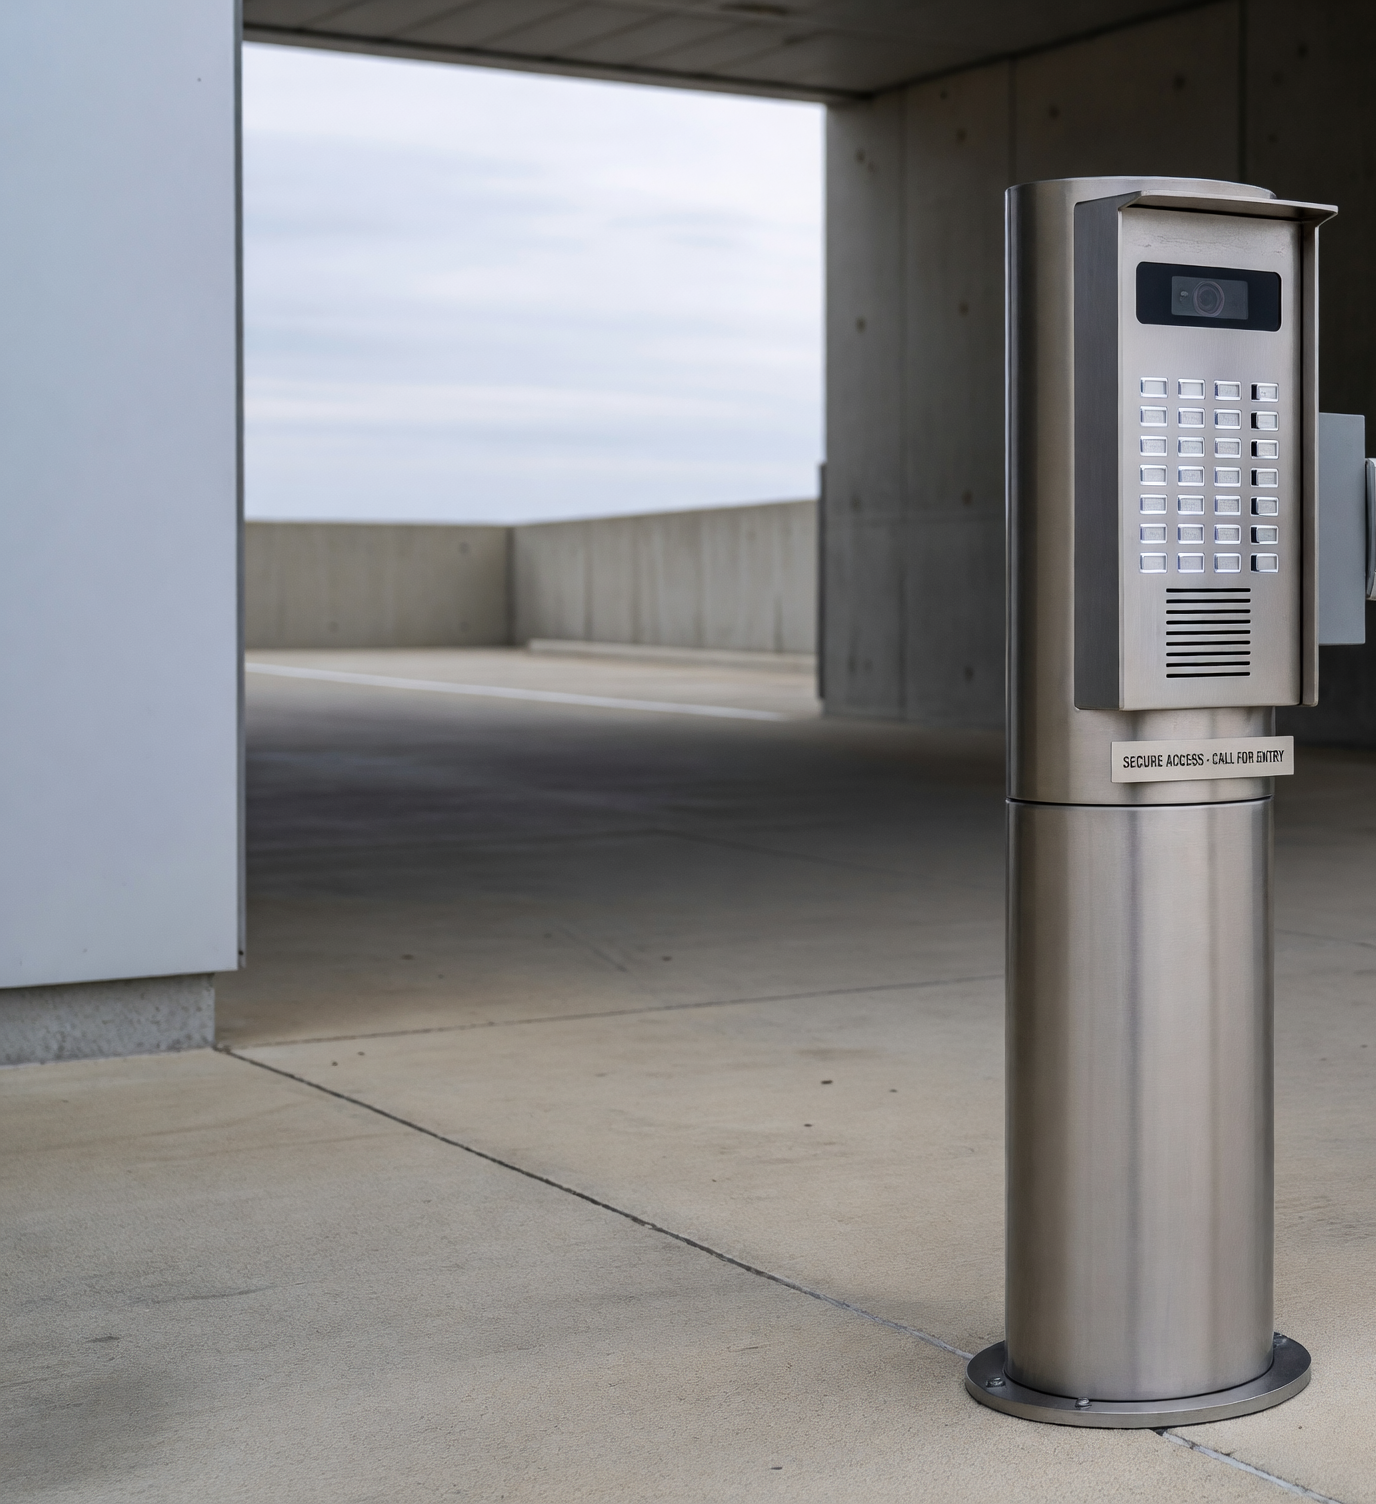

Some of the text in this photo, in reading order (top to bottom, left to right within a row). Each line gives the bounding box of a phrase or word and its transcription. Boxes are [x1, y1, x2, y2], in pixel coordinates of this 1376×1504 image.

[1123, 754, 1163, 769] SECURE
[1166, 753, 1204, 767] ACCESS
[1212, 752, 1235, 765] CALL
[1237, 751, 1254, 764] FOR
